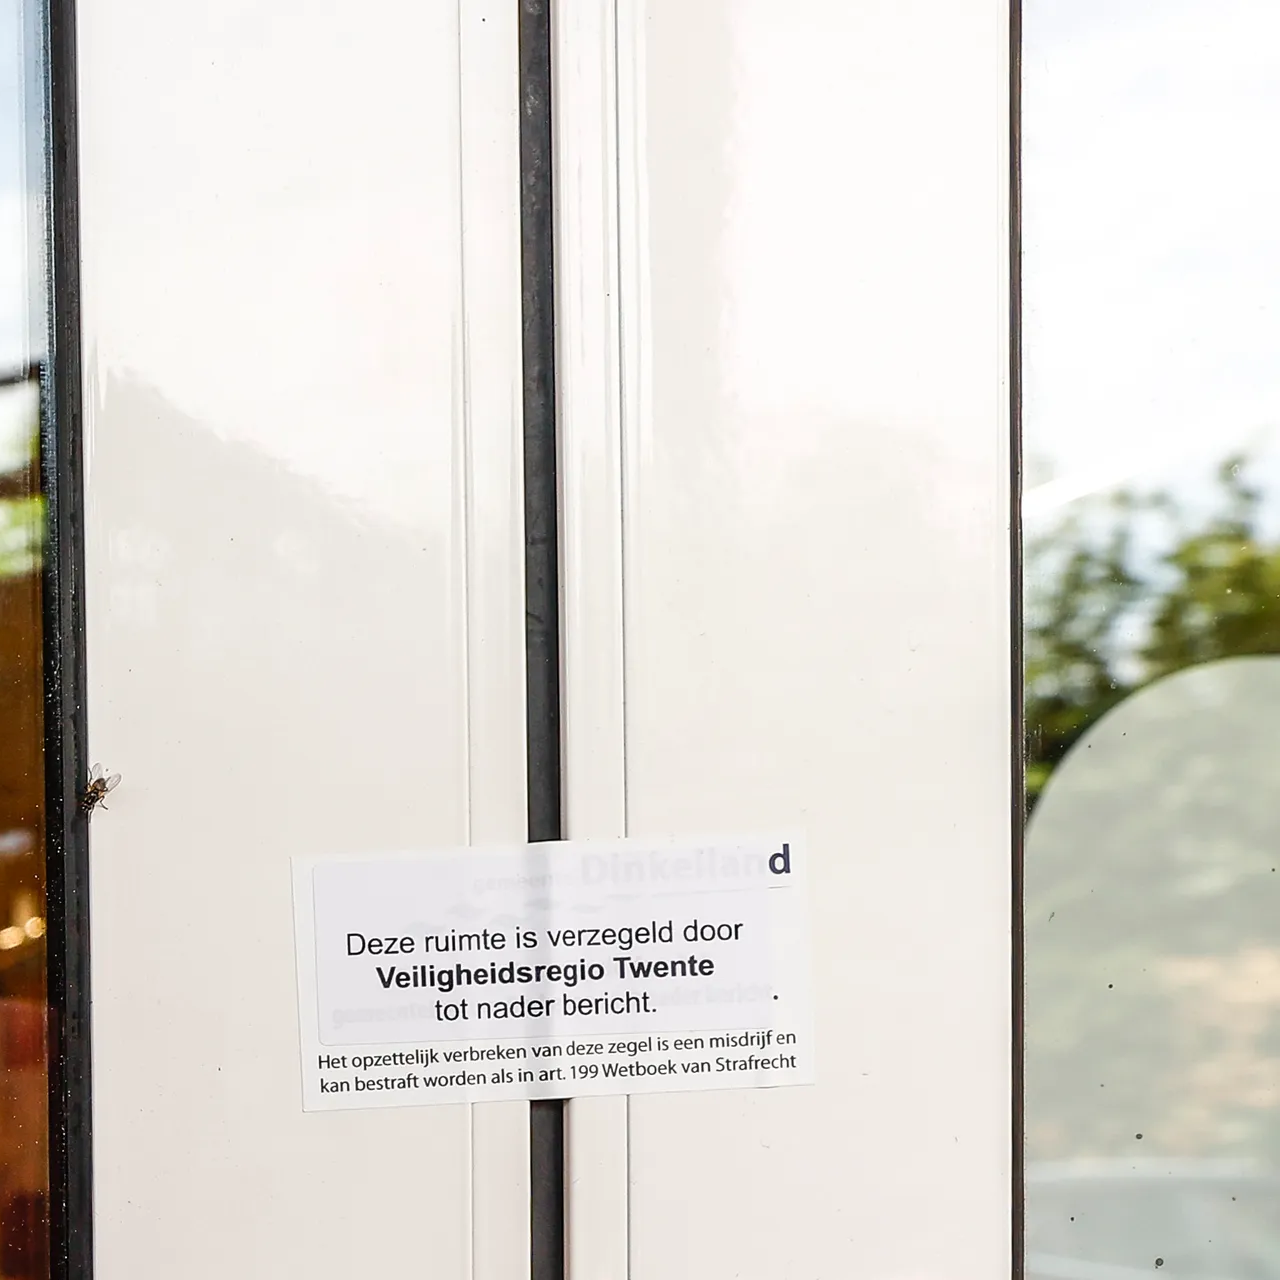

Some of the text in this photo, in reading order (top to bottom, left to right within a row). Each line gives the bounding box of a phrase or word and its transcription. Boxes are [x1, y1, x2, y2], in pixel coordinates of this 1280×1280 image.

[347, 919, 743, 956] Deze ruimte is verzegeld door
[376, 955, 714, 993] Veiligheidsregio Twente
[435, 999, 469, 1021] tot
[477, 995, 555, 1019] nader
[563, 991, 656, 1016] bericht.
[318, 1030, 796, 1071] Het opzettelijk verbreken van deze zegel is een misdrijf en
[320, 1054, 796, 1093] kan bestraft worden als in art. 199 Wetboek van Strafrecht
